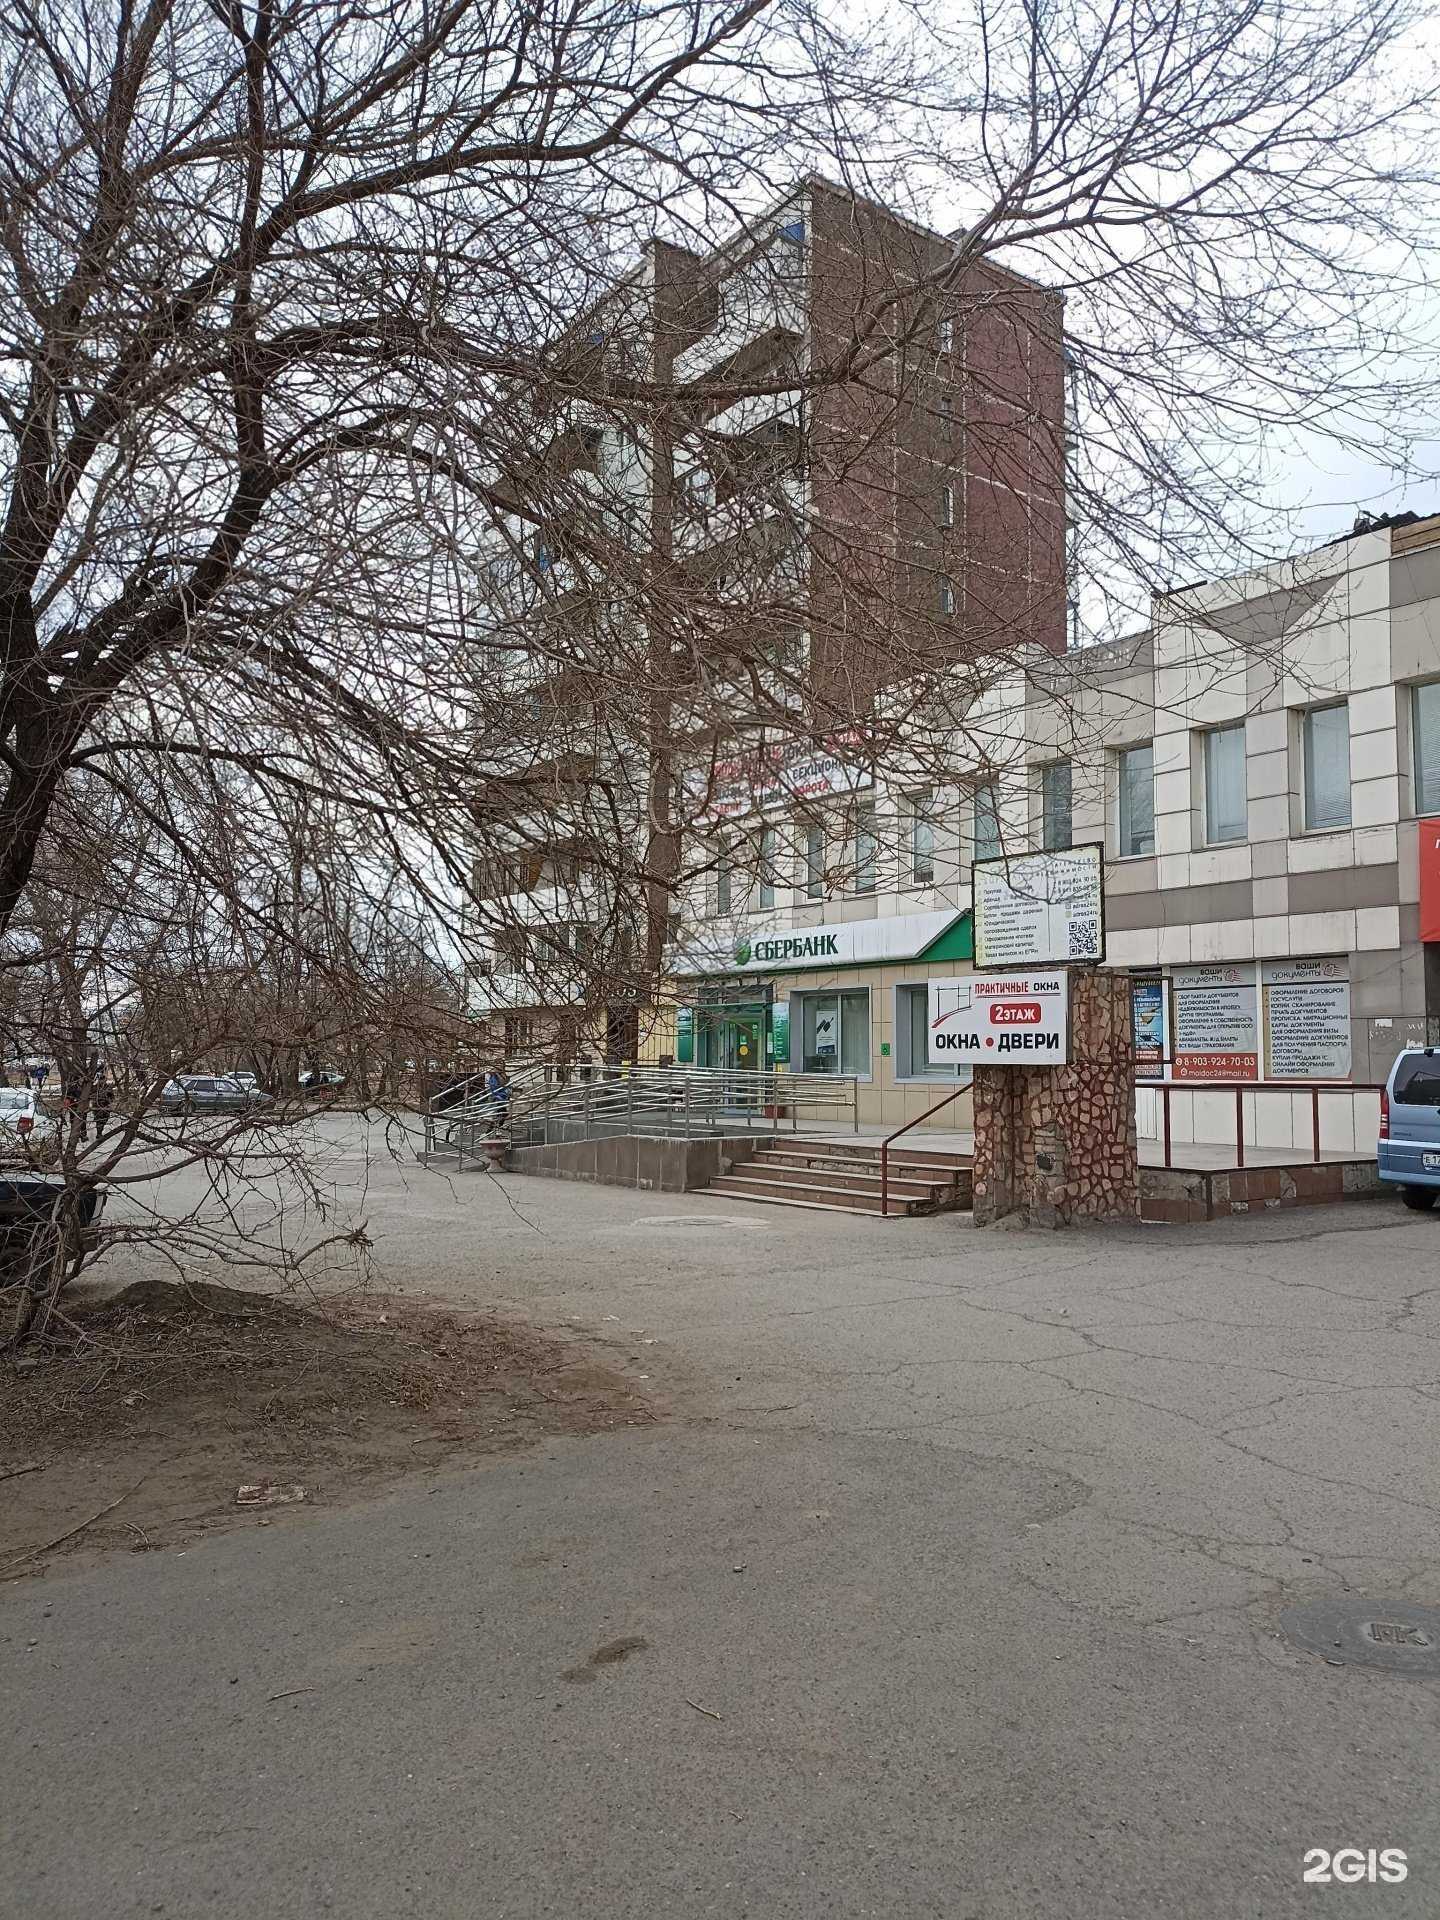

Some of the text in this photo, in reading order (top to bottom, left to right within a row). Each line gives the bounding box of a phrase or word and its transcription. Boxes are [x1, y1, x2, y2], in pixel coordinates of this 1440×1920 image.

[755, 934, 839, 961] СБЕРБАНК
[974, 981, 1060, 994] ПРАКТИЧНЫЕ ОКНА
[935, 1033, 1060, 1053] ОКНА ДВЕРИ
[1184, 1057, 1255, 1066] 8-903-924-70-03
